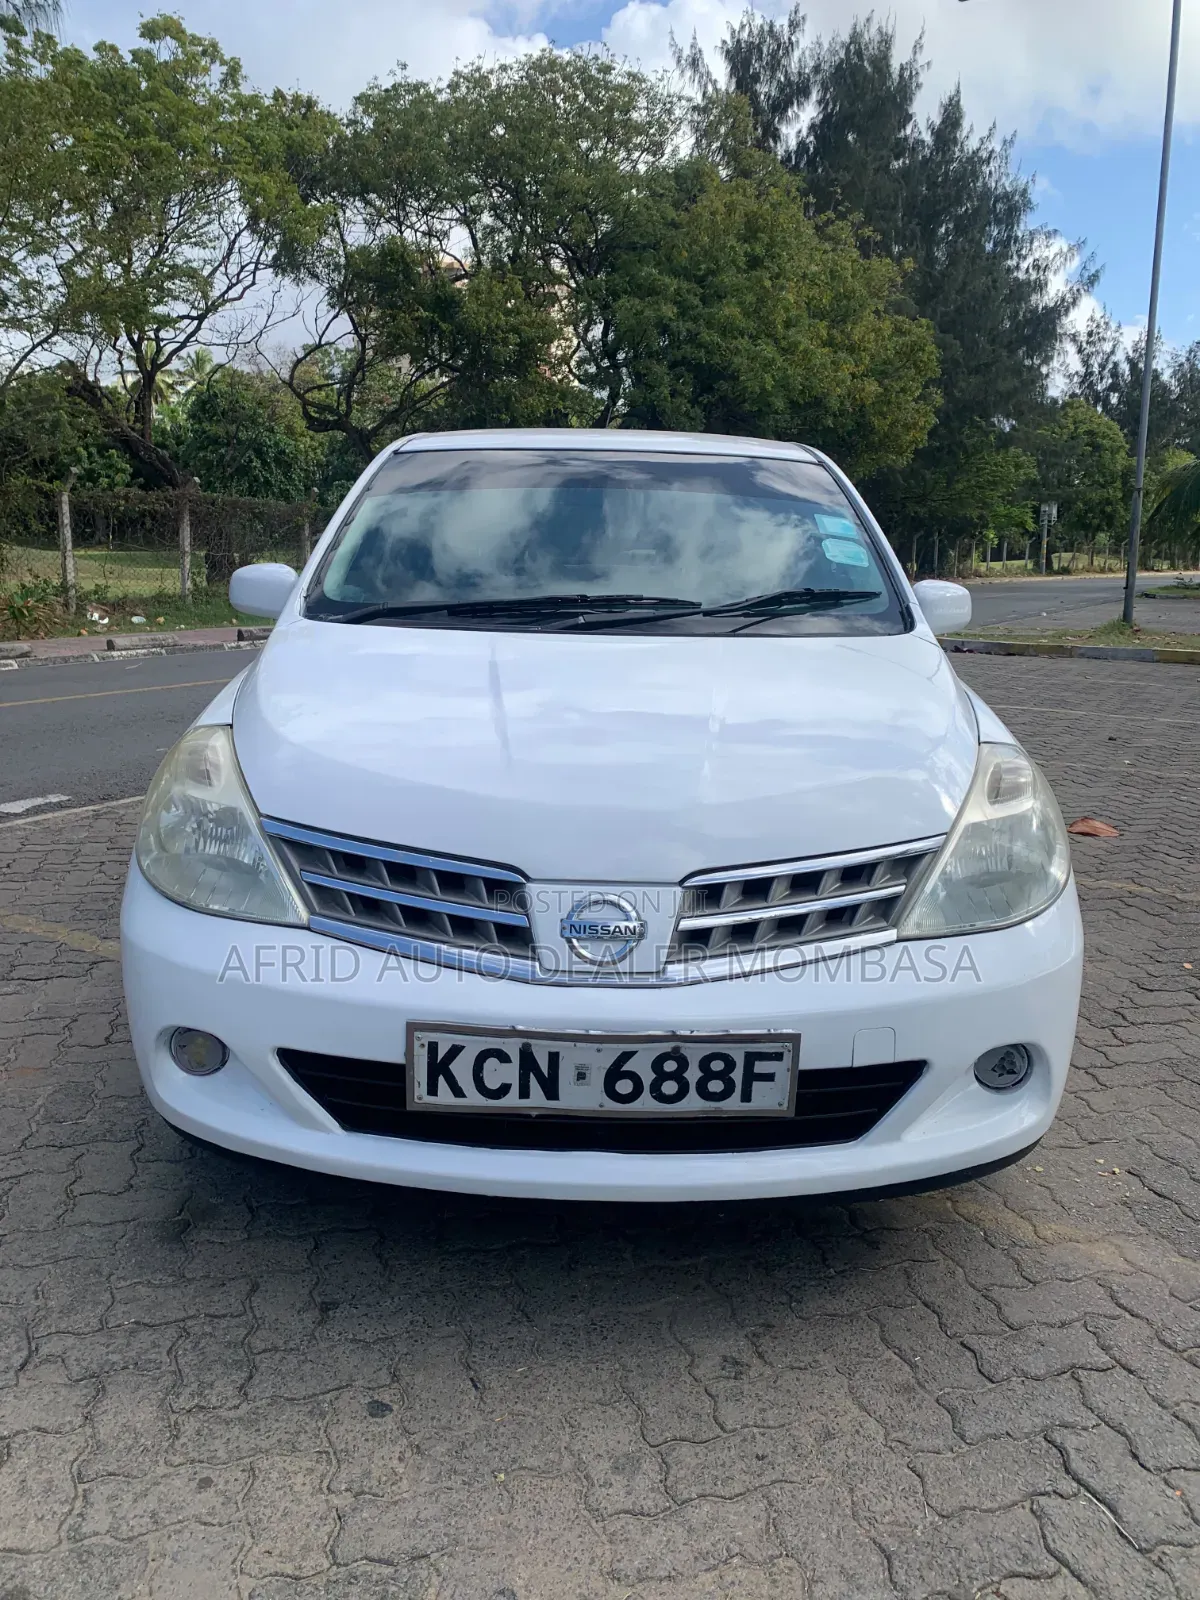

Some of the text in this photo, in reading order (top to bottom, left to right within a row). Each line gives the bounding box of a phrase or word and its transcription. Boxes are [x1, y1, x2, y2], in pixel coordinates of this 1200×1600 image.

[568, 923, 637, 936] NISSAN
[426, 1040, 784, 1105] KCN 688F
